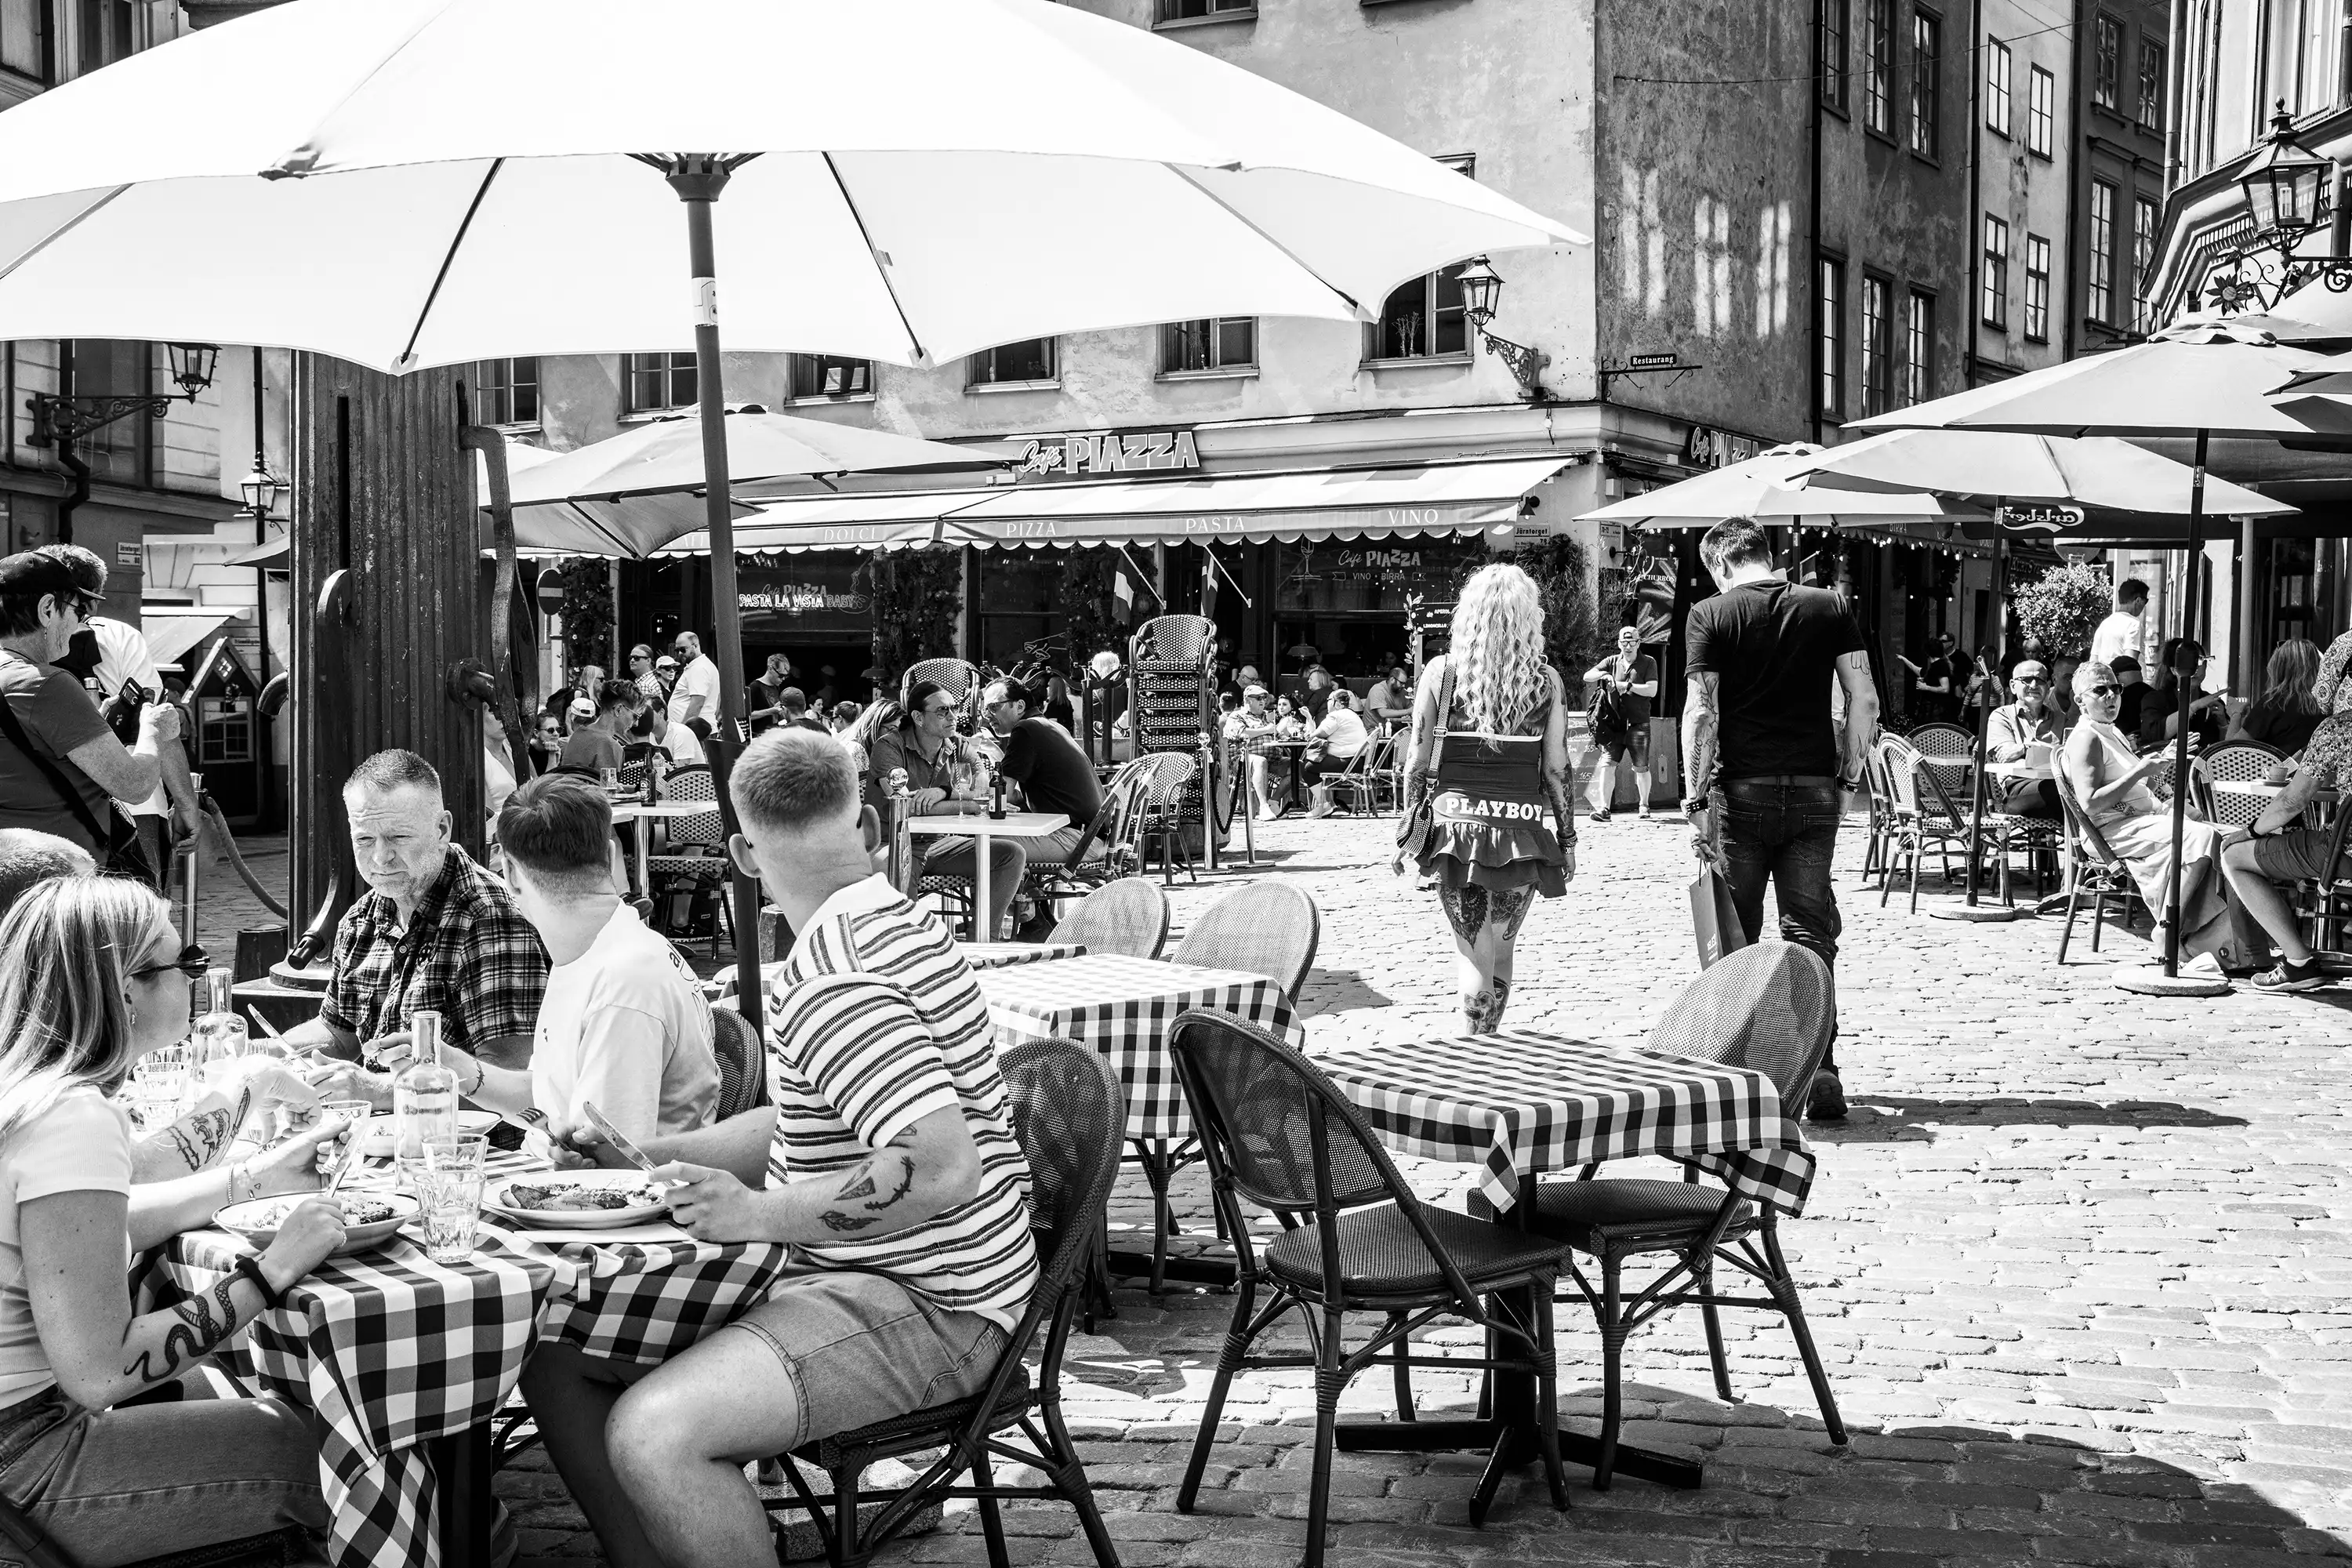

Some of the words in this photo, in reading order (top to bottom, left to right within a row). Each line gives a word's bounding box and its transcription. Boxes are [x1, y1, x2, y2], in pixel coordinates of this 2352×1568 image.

[1018, 440, 1063, 475] Café
[1065, 431, 1200, 474] PIAZZA
[1185, 517, 1245, 532] PASTA
[1388, 509, 1439, 525] VINO
[1006, 522, 1057, 537] PIZZA
[1516, 528, 1548, 536] Järntorget
[1338, 550, 1363, 568] Café
[1366, 549, 1421, 567] PIAZZA
[1381, 572, 1405, 581] BIRRA
[739, 593, 773, 608] PASTA
[775, 593, 790, 608] LA
[793, 593, 824, 608] VISTA
[826, 594, 855, 608] BABY
[1445, 798, 1543, 822] PLAYBOY
